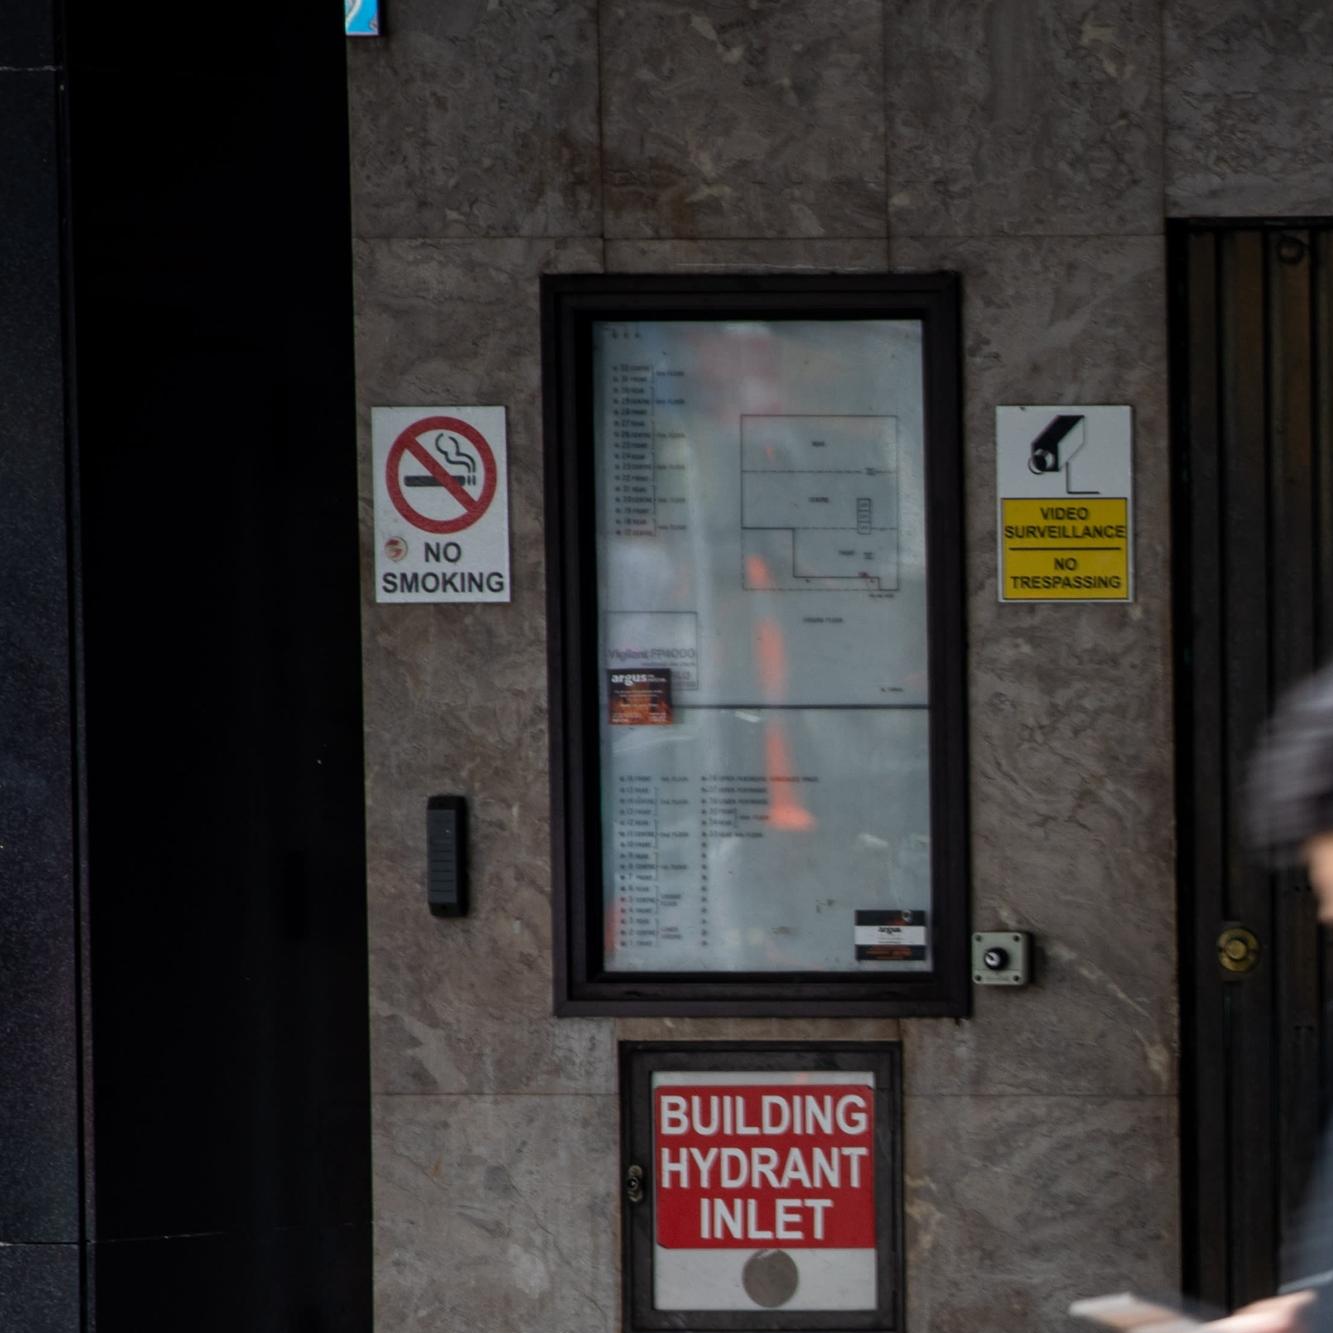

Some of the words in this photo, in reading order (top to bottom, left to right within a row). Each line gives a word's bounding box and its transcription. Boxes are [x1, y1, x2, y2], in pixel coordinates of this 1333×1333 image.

[1040, 507, 1089, 520] VIDEO
[1004, 525, 1127, 539] SURVEILLANCE
[424, 542, 462, 563] NO
[1054, 557, 1077, 571] NO
[382, 572, 504, 593] SMOKING
[1010, 576, 1121, 589] TRESPASSING
[611, 673, 647, 687] argus
[660, 1095, 868, 1135] BUILDING
[660, 1147, 868, 1189] HYDRANT
[700, 1198, 833, 1240] INLET
